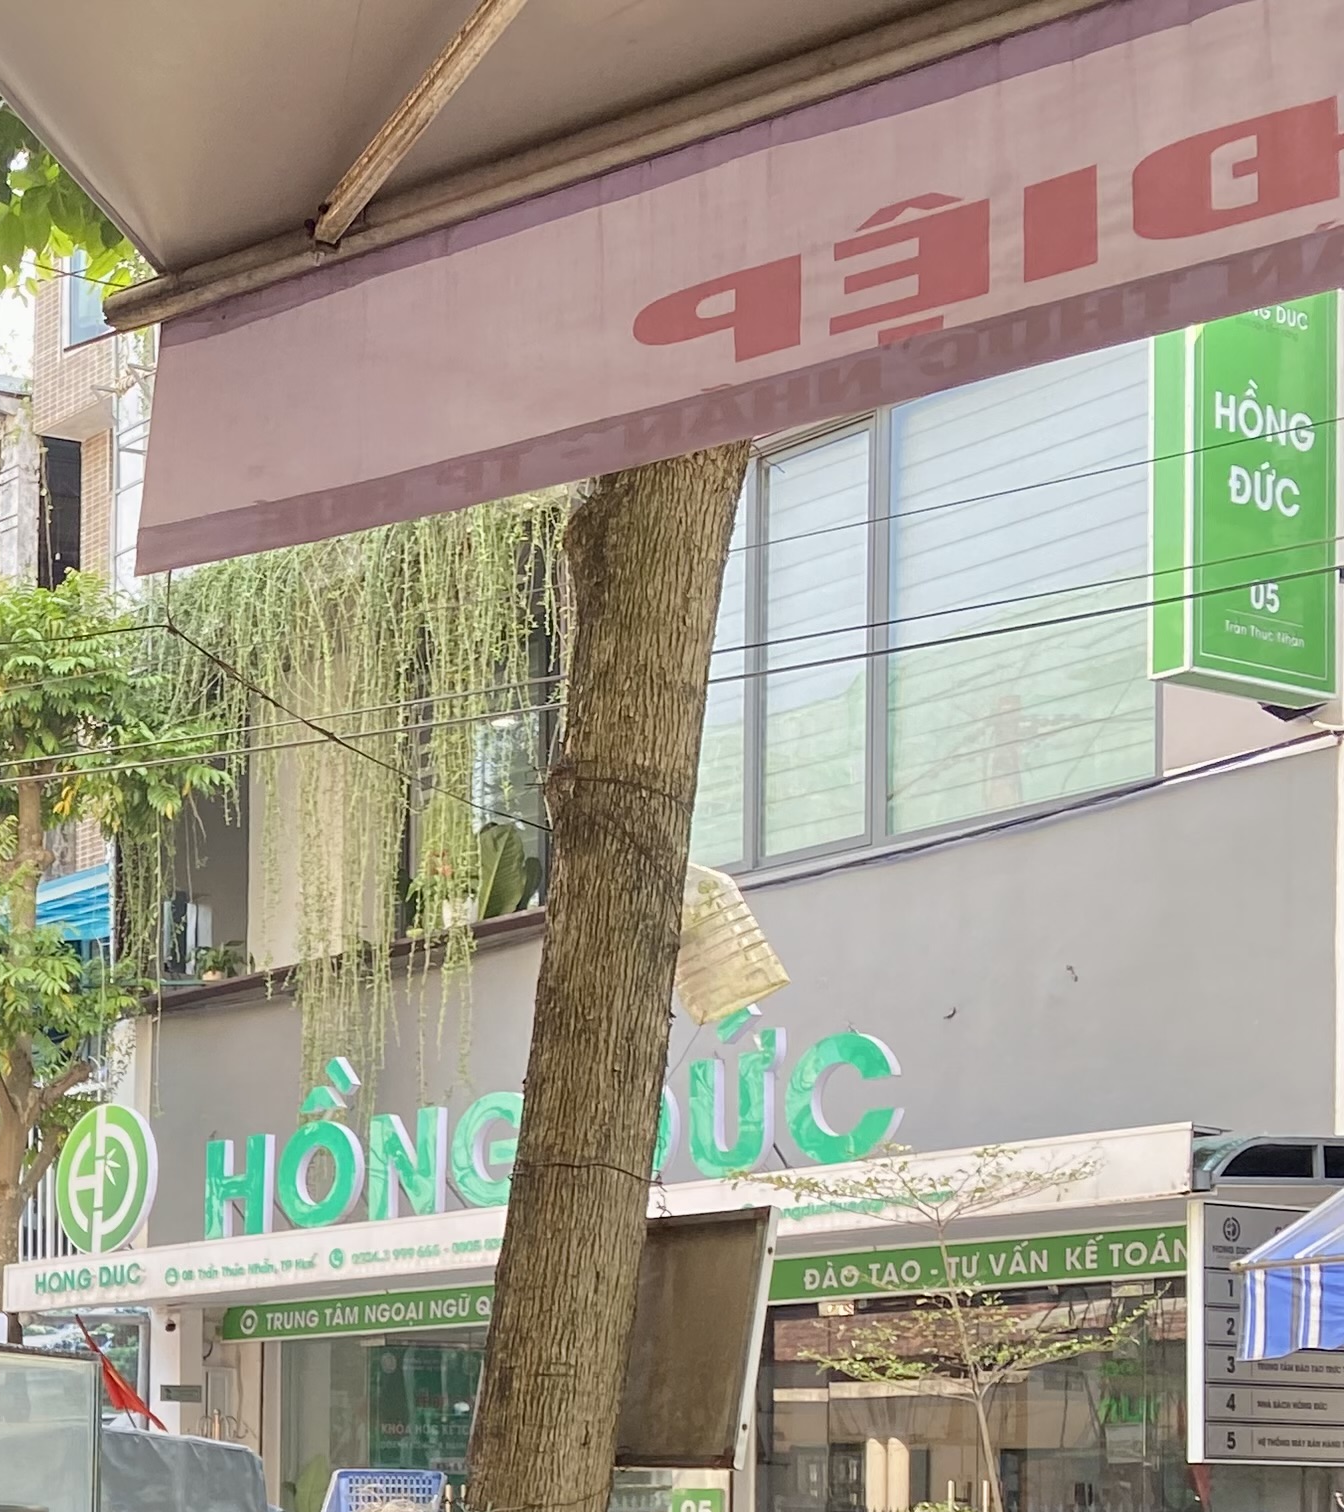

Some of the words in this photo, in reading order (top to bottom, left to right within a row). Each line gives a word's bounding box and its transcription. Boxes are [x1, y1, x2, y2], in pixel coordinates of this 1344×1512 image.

[1214, 379, 1316, 452] HỒNG
[1229, 462, 1301, 518] ĐỨC
[1250, 580, 1280, 613] 05
[651, 1003, 904, 1181] ỨC
[204, 1056, 525, 1240] HỒNG
[988, 1240, 1048, 1277] VẤN
[1065, 1234, 1104, 1271] KẾ
[1109, 1233, 1187, 1268] TOÁN
[1227, 1279, 1234, 1297] 1
[266, 1310, 319, 1331] TRUNG
[324, 1302, 359, 1327] TÂM
[364, 1299, 424, 1326] NGOẠI
[429, 1293, 471, 1319] NGỮ
[1226, 1317, 1235, 1335] 2
[1226, 1355, 1236, 1373] 3
[1226, 1393, 1236, 1411] 4
[1227, 1431, 1236, 1449] 5
